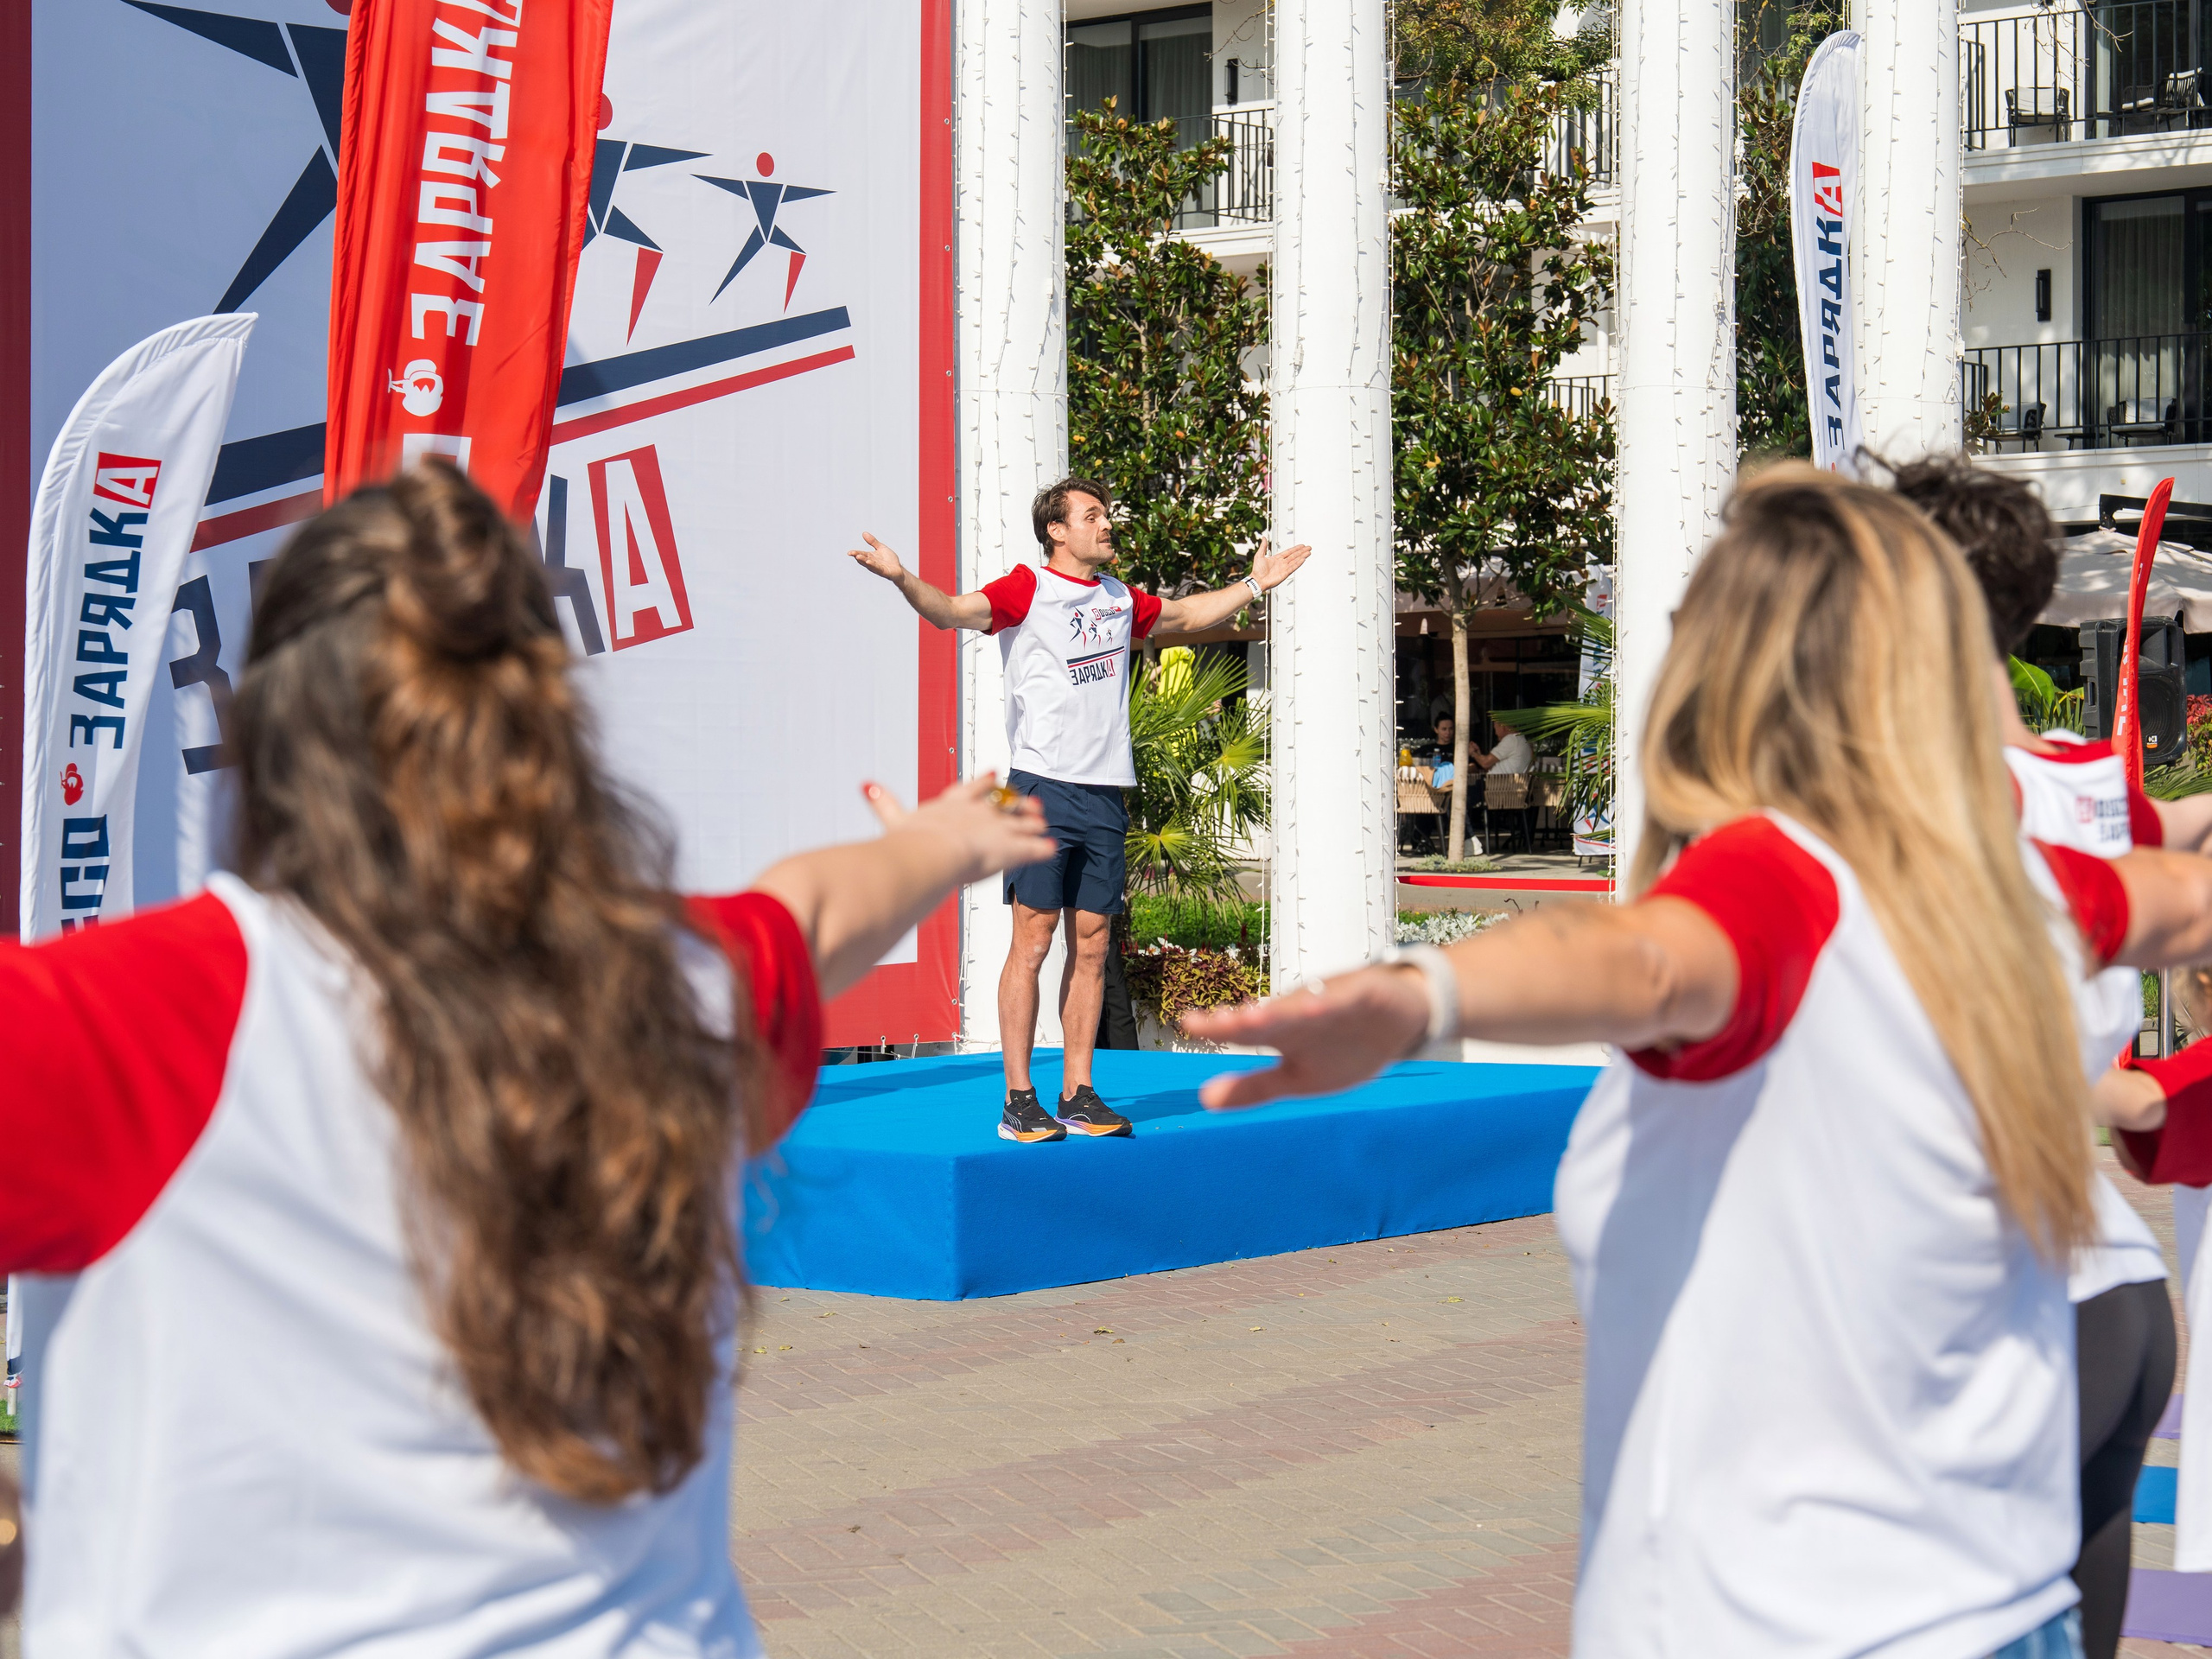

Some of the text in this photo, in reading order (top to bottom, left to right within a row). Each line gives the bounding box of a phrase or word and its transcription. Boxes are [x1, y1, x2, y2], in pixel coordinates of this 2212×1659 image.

[1812, 162, 1845, 450] ЗАРЯДКА
[70, 452, 162, 749] ЗАРЯДКА
[1069, 658, 1116, 685] ЗАРЯДКА
